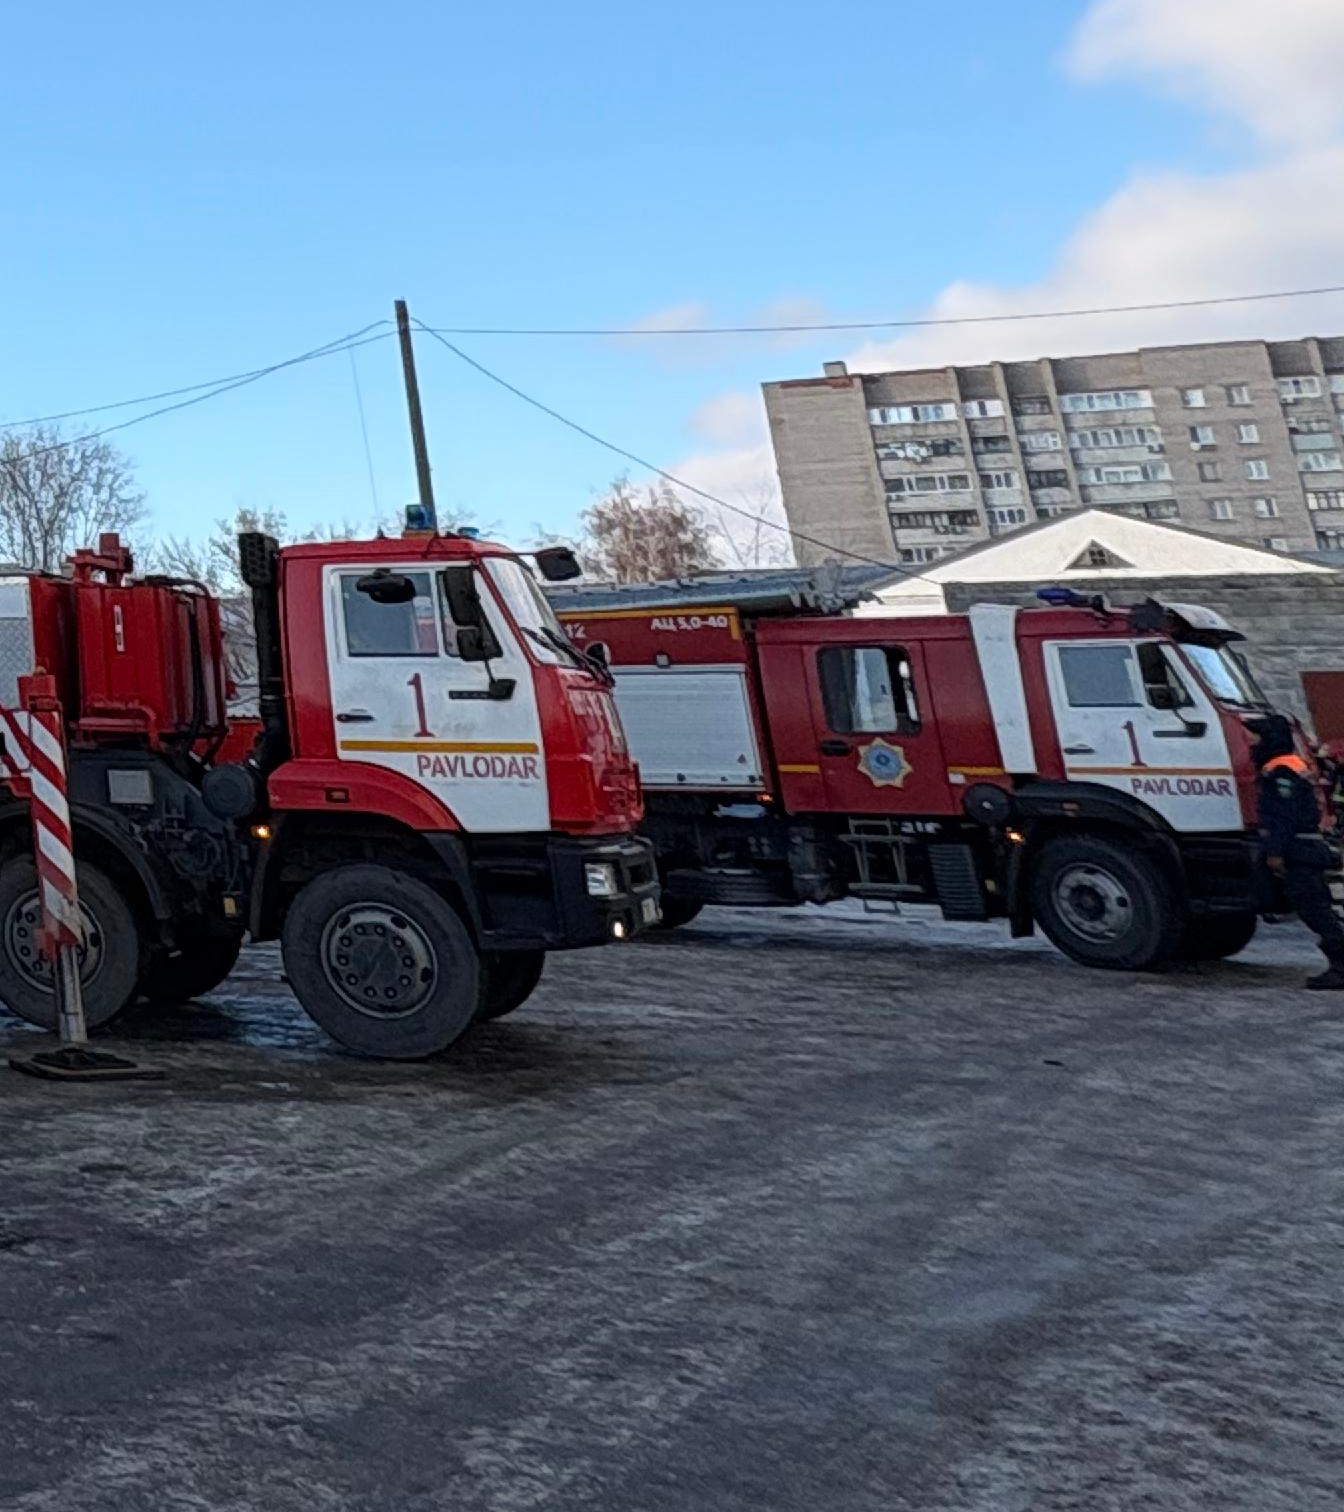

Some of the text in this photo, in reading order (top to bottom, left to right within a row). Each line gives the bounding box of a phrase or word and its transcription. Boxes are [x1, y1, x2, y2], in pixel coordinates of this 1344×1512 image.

[407, 672, 435, 738] 1
[1121, 720, 1148, 767] 1
[417, 754, 541, 780] PAVLODAR
[1131, 777, 1233, 796] PAVLODAR
